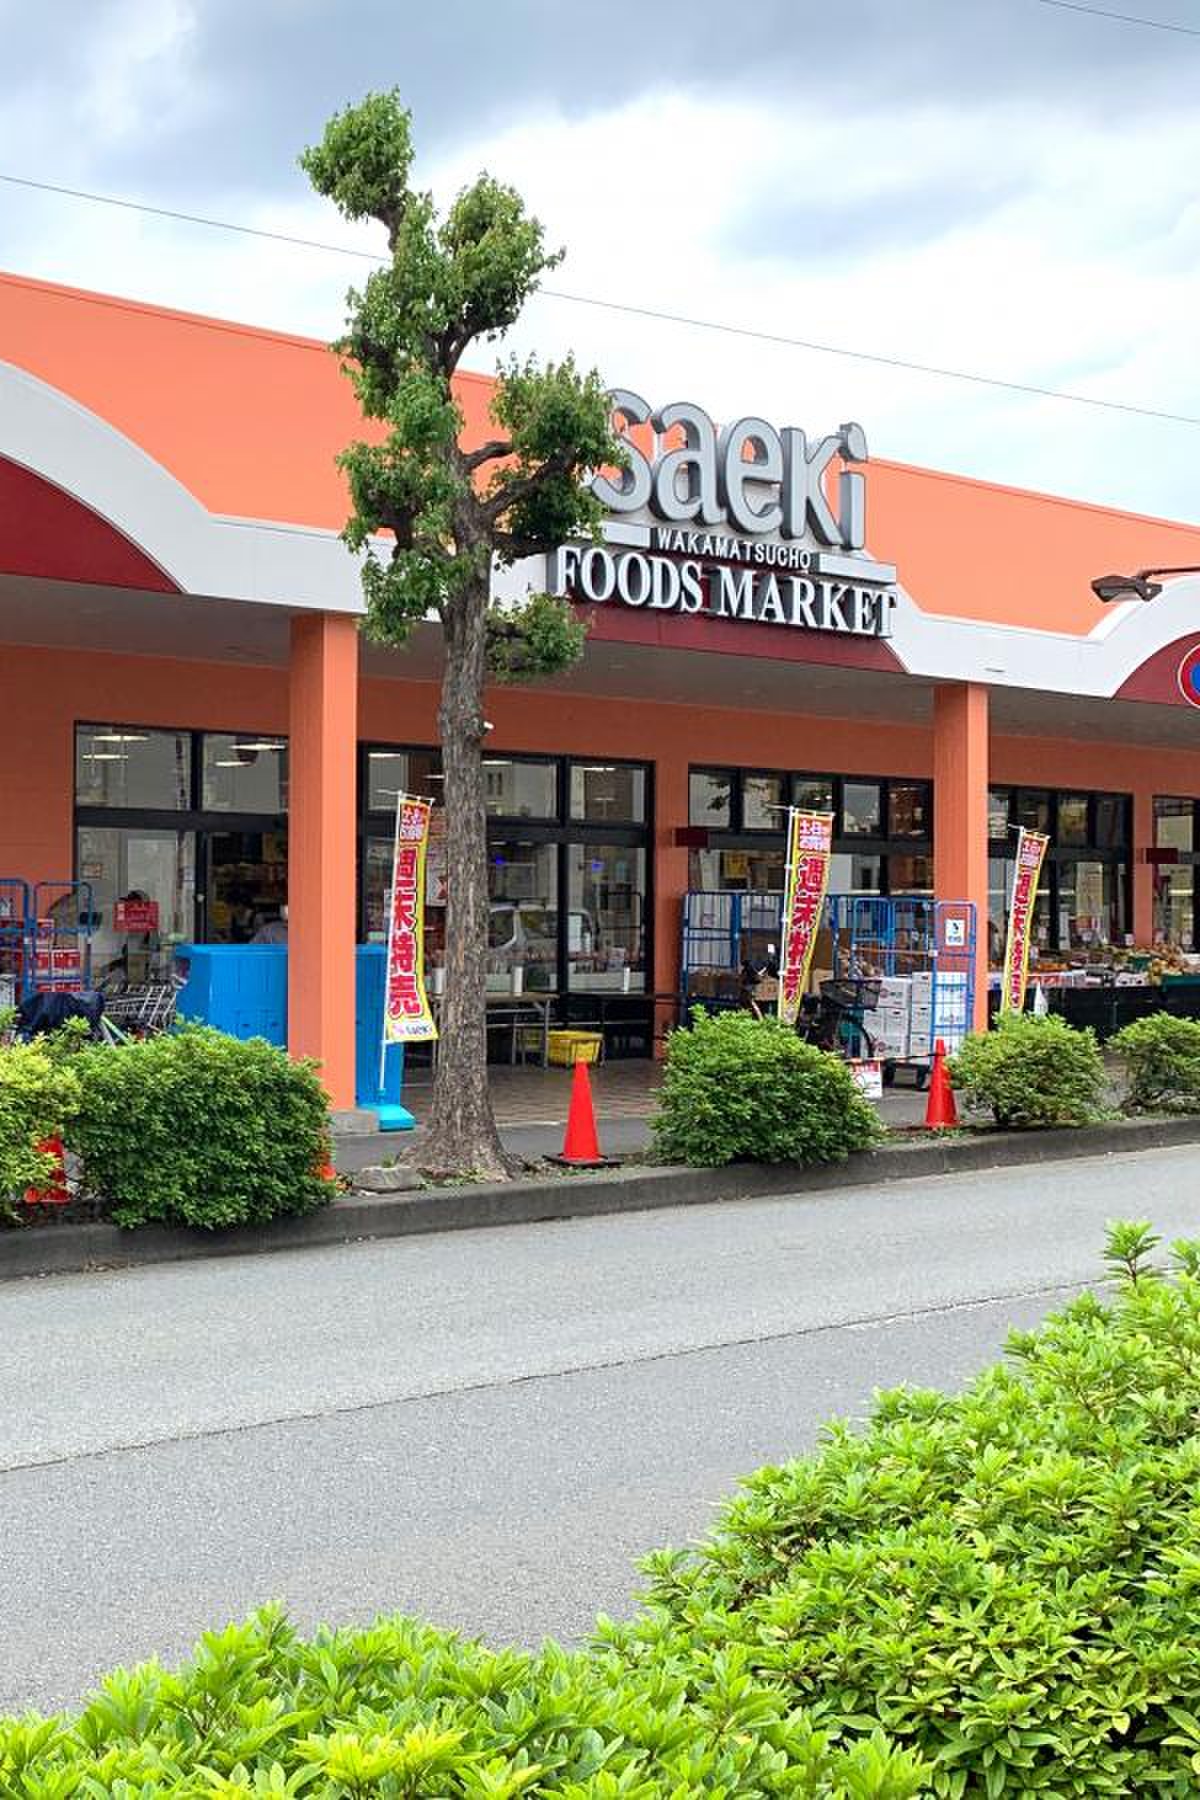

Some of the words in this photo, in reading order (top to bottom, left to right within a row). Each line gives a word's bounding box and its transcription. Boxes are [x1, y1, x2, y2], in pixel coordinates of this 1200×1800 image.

[590, 388, 868, 549] saeki
[554, 545, 704, 614] FOODS
[717, 564, 897, 639] MARKET
[657, 527, 812, 570] WAKAMATSUCHO
